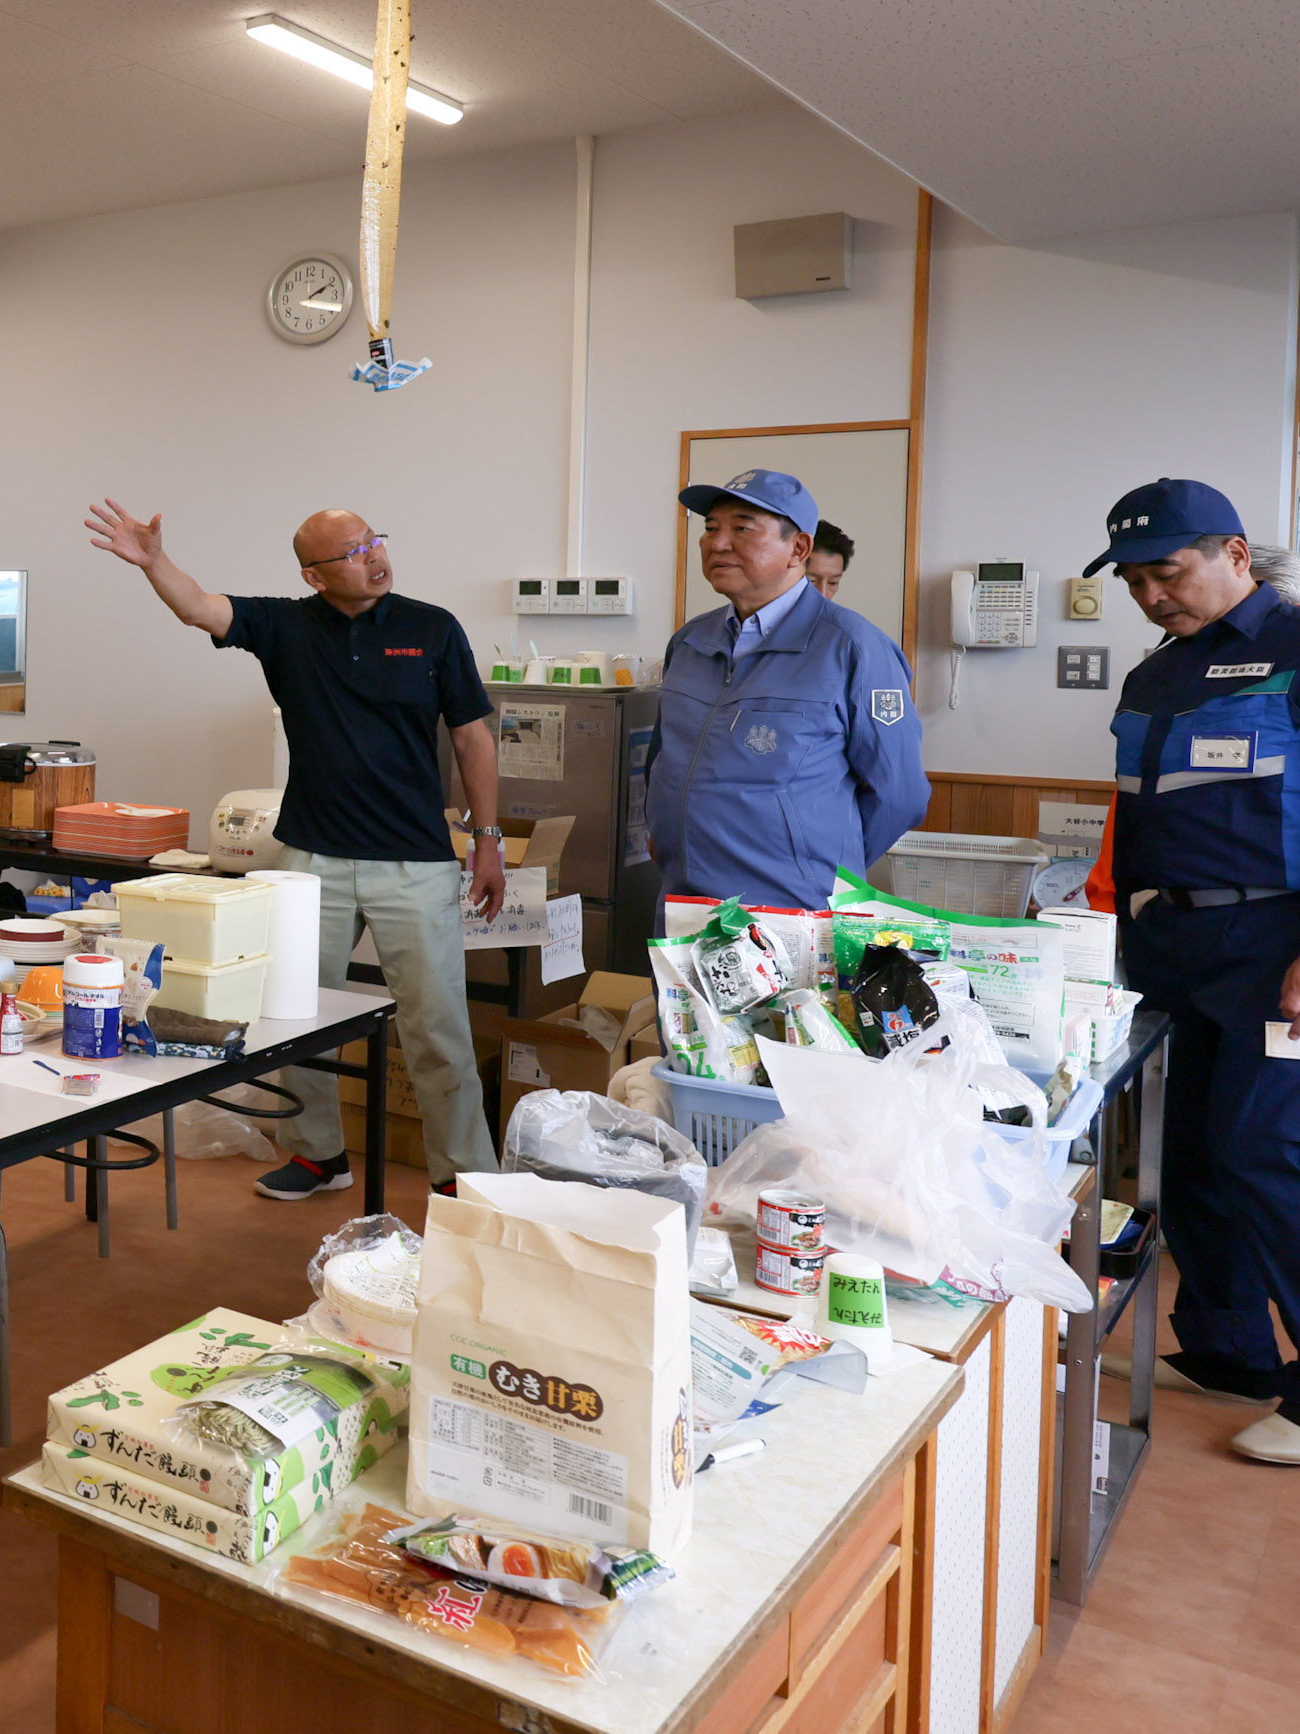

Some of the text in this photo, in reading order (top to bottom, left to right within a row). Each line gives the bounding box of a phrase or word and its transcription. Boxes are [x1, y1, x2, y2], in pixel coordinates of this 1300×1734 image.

[294, 271, 302, 282] 11
[306, 265, 316, 277] 12
[320, 269, 325, 279] 1
[284, 281, 294, 292] 10
[328, 276, 335, 287] 2
[282, 295, 289, 306] 9
[332, 290, 339, 301] 3
[285, 307, 292, 318] 8
[294, 317, 300, 328] 7
[305, 319, 313, 330] 6
[318, 314, 326, 325] 5
[833, 1276, 880, 1295] みえたん
[453, 1355, 598, 1418] 有機 むき甘栗
[100, 1428, 199, 1482] ずんだ饅頭
[103, 1480, 206, 1535] ずんだ饅頭
